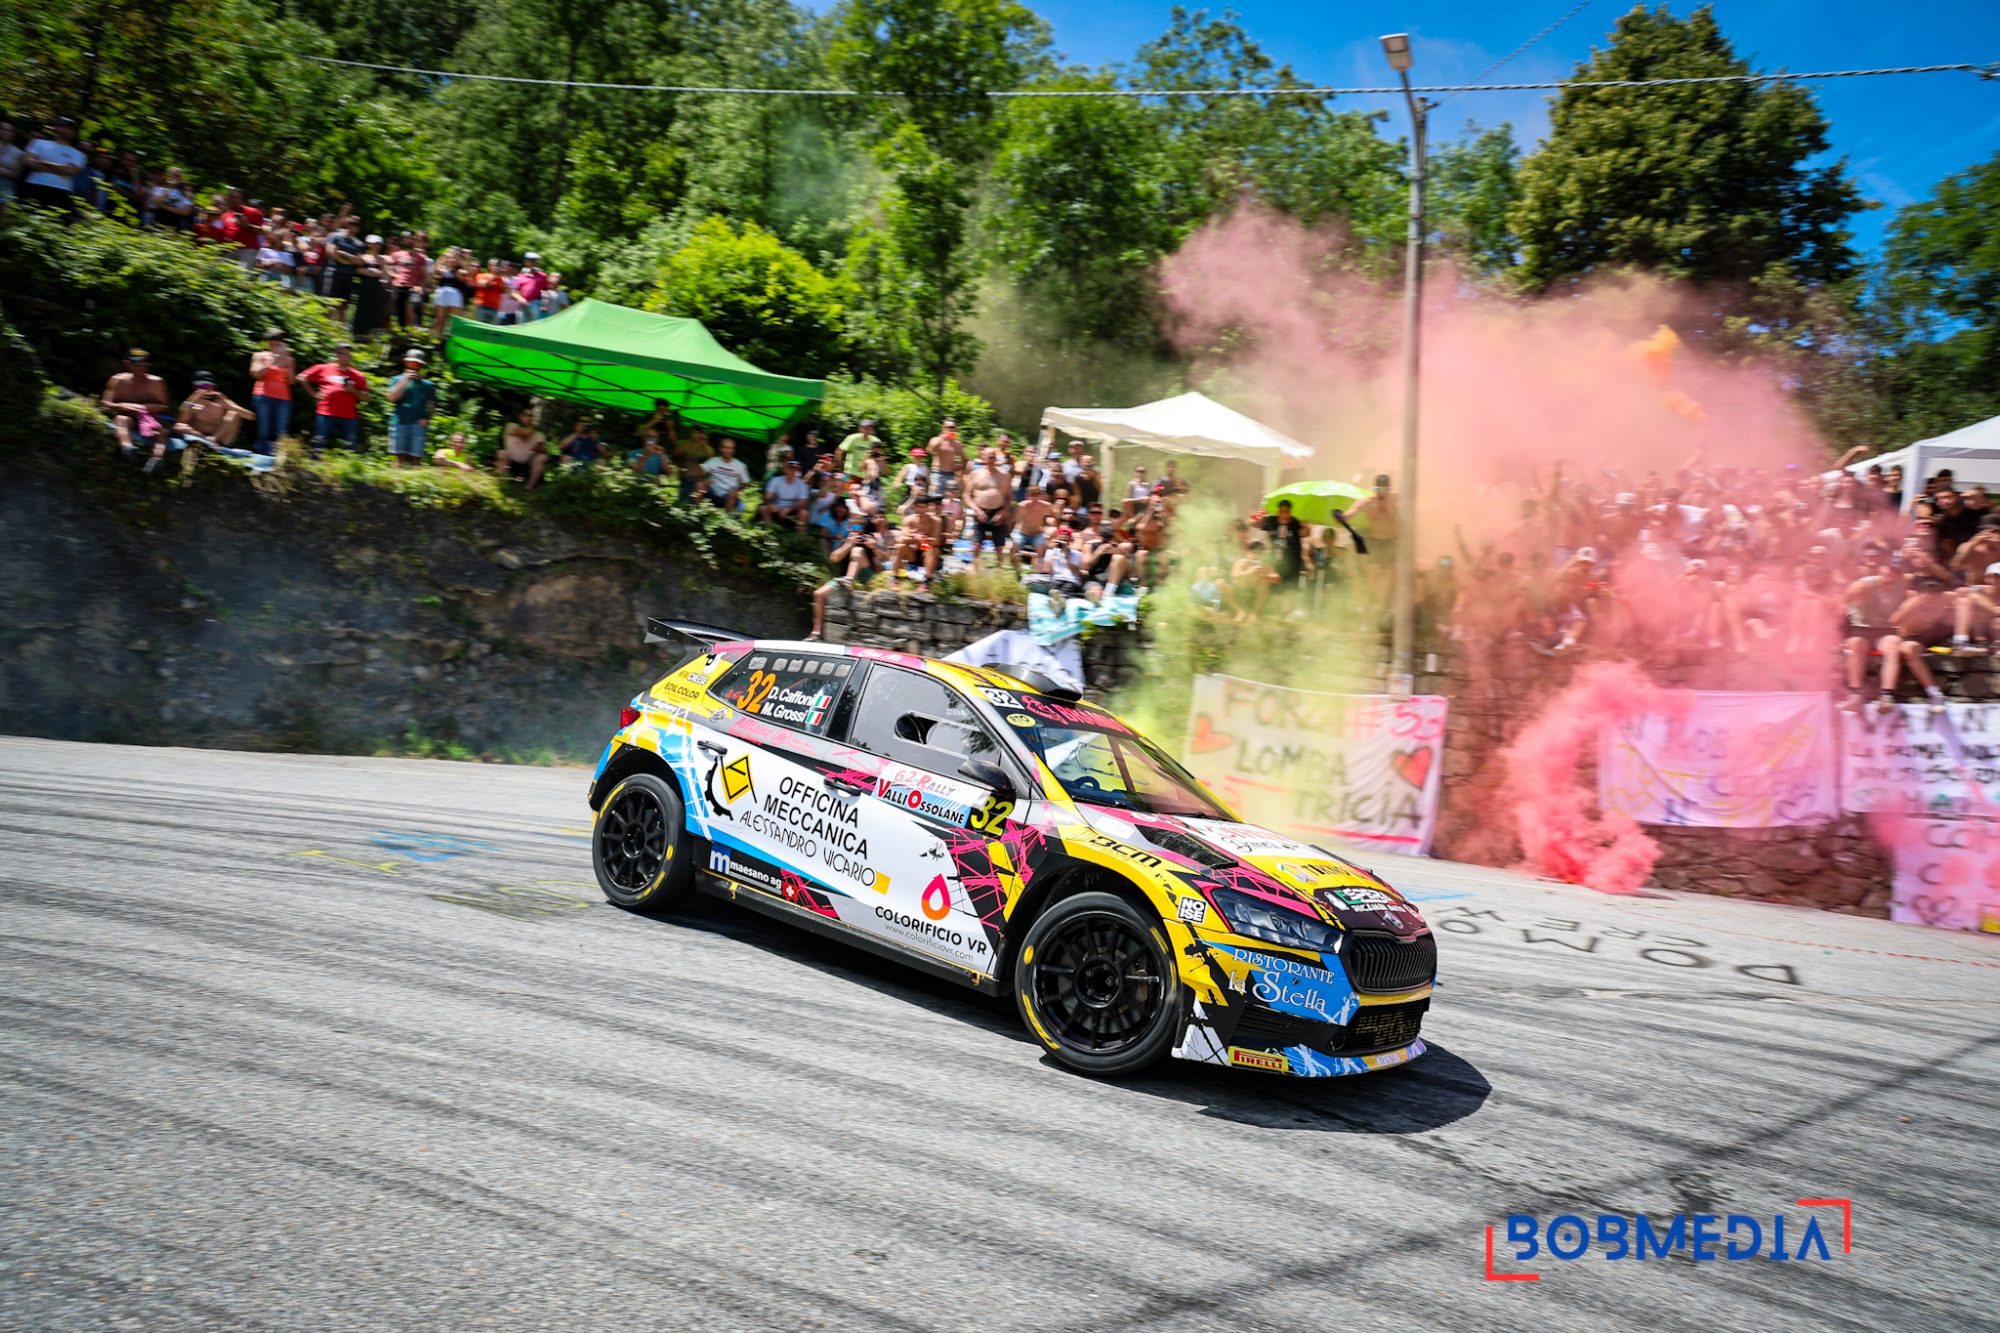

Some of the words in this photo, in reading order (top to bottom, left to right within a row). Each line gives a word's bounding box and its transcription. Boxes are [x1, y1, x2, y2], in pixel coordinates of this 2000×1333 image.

[737, 669, 776, 714] 32
[761, 702, 773, 717] M.
[773, 704, 807, 723] Grossi
[767, 686, 778, 700] D.
[778, 688, 818, 708] Caffoni
[984, 688, 1019, 707] 32
[779, 776, 859, 829] OFFICINA
[970, 795, 1014, 836] 32
[739, 809, 817, 858] ALESSANDRO
[823, 846, 876, 887] VICARIO
[763, 794, 868, 860] MECCANICA
[730, 860, 769, 883] maesano
[769, 875, 782, 890] ag
[875, 905, 962, 946] COLORIFICIO
[967, 937, 988, 955] VR
[1233, 948, 1335, 986] RISTORANTE
[1437, 918, 1801, 986] DOMO
[1227, 970, 1247, 993] la
[1252, 970, 1326, 1013] Stella
[1234, 1049, 1283, 1070] PIRELLI
